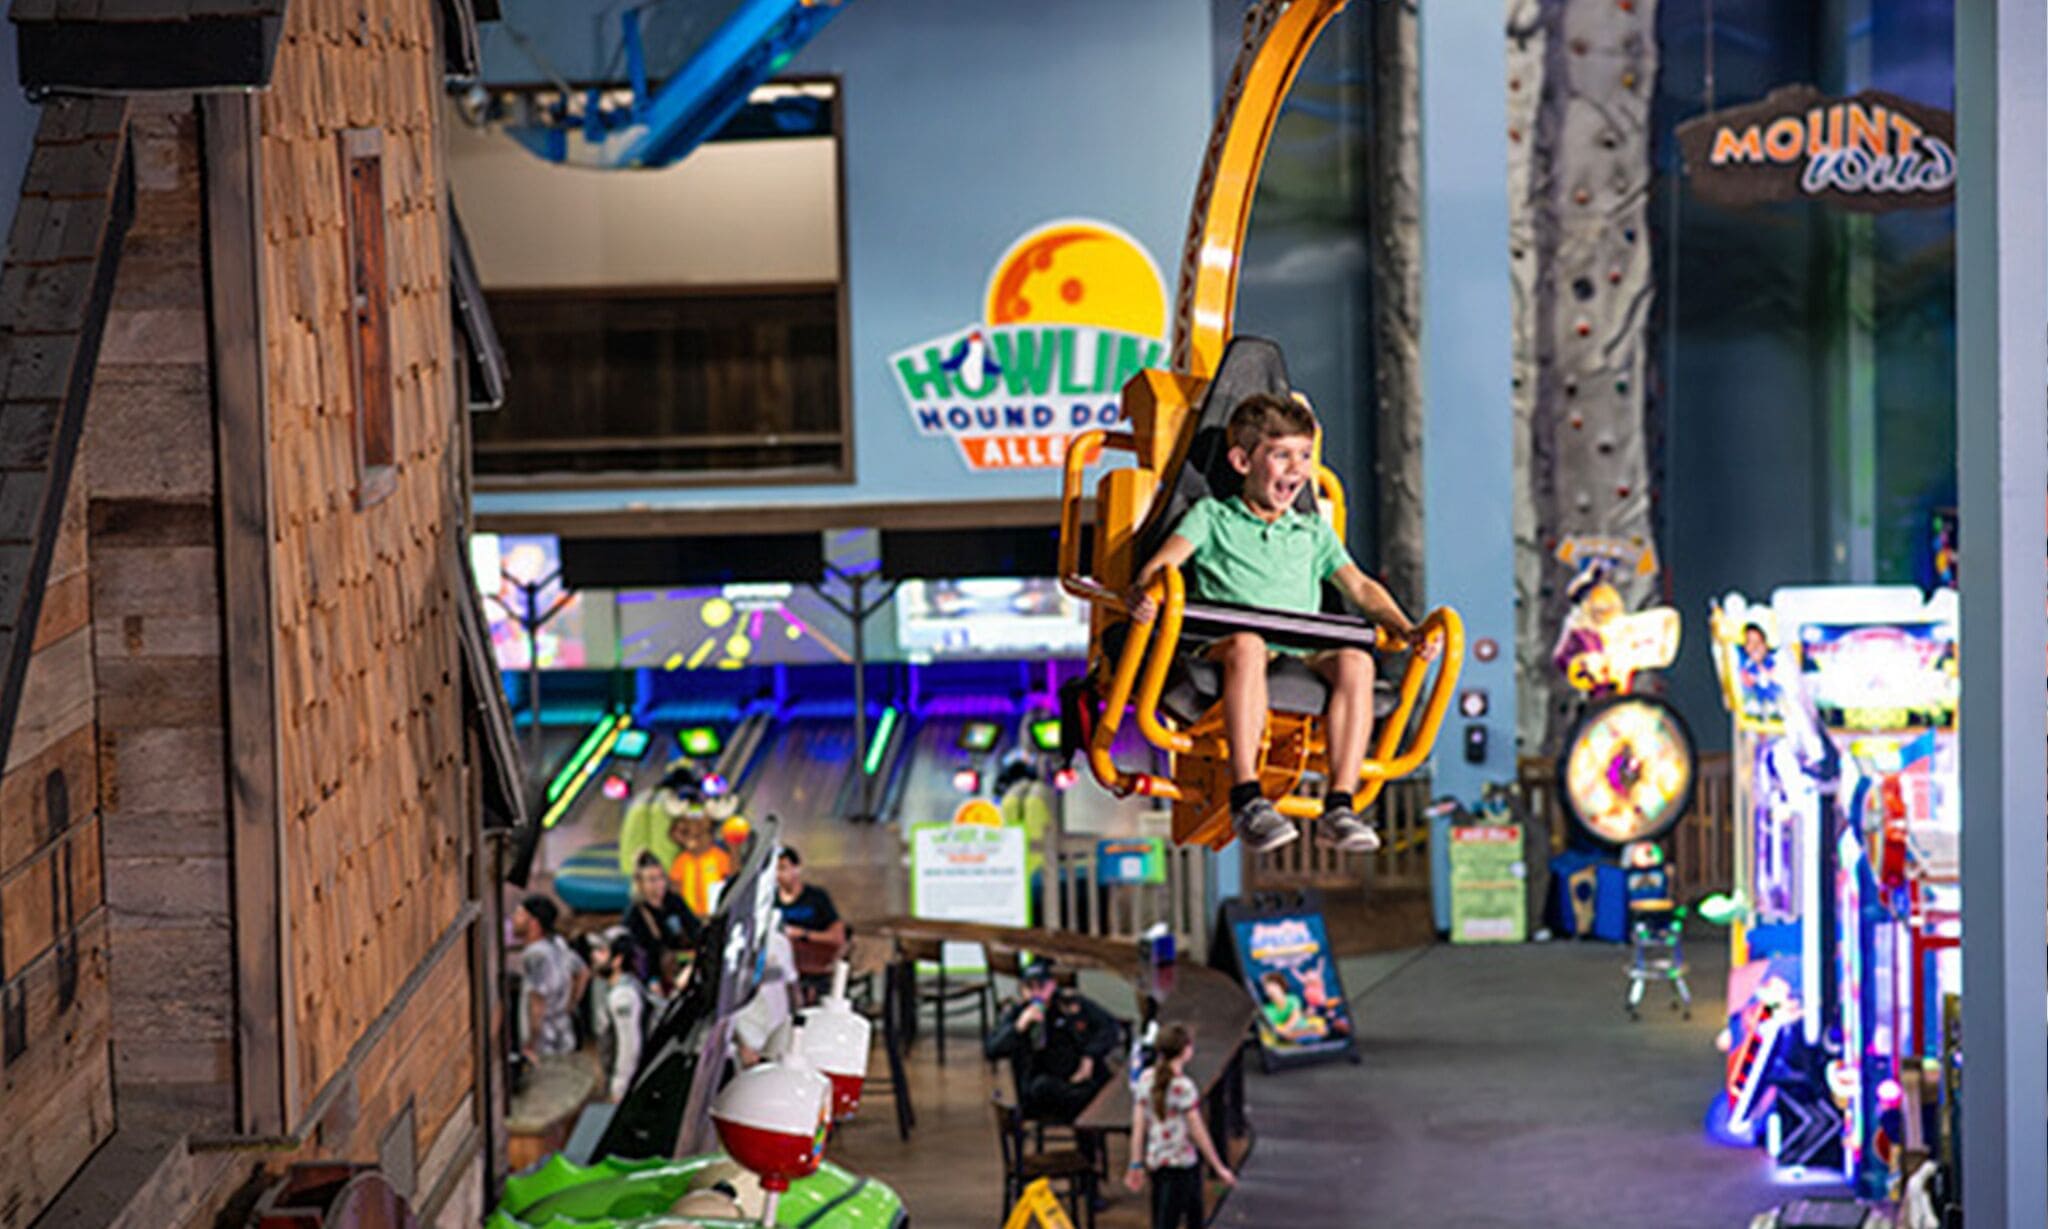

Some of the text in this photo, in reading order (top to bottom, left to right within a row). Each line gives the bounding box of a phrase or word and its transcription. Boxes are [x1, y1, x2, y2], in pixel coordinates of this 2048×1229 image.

[1712, 103, 1921, 164] MOUNT
[1802, 136, 1956, 193] Wild
[897, 329, 1171, 399] HOWLIN
[918, 402, 1120, 430] HOUND DO
[983, 438, 1064, 465] ALLE
